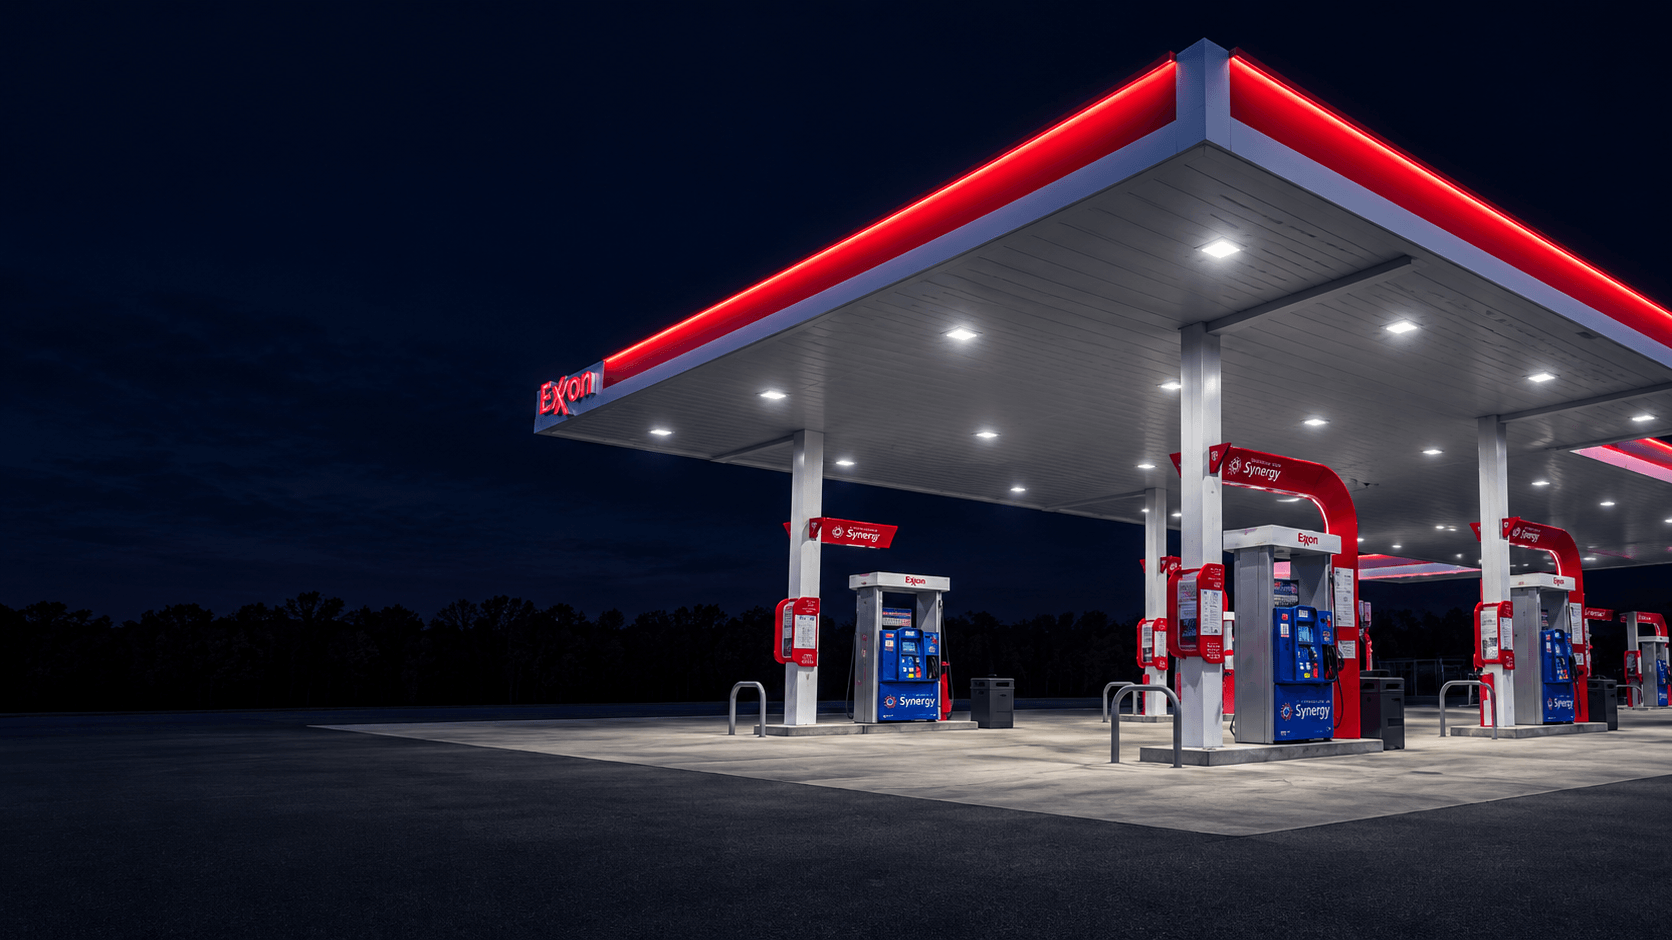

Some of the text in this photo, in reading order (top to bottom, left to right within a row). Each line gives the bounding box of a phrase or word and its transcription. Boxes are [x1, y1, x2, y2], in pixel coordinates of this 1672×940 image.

[539, 370, 592, 415] Exxon
[1243, 461, 1281, 482] Synergy
[1297, 532, 1318, 547] Exxon
[899, 696, 935, 708] Synergy
[1295, 703, 1330, 720] Synergy
